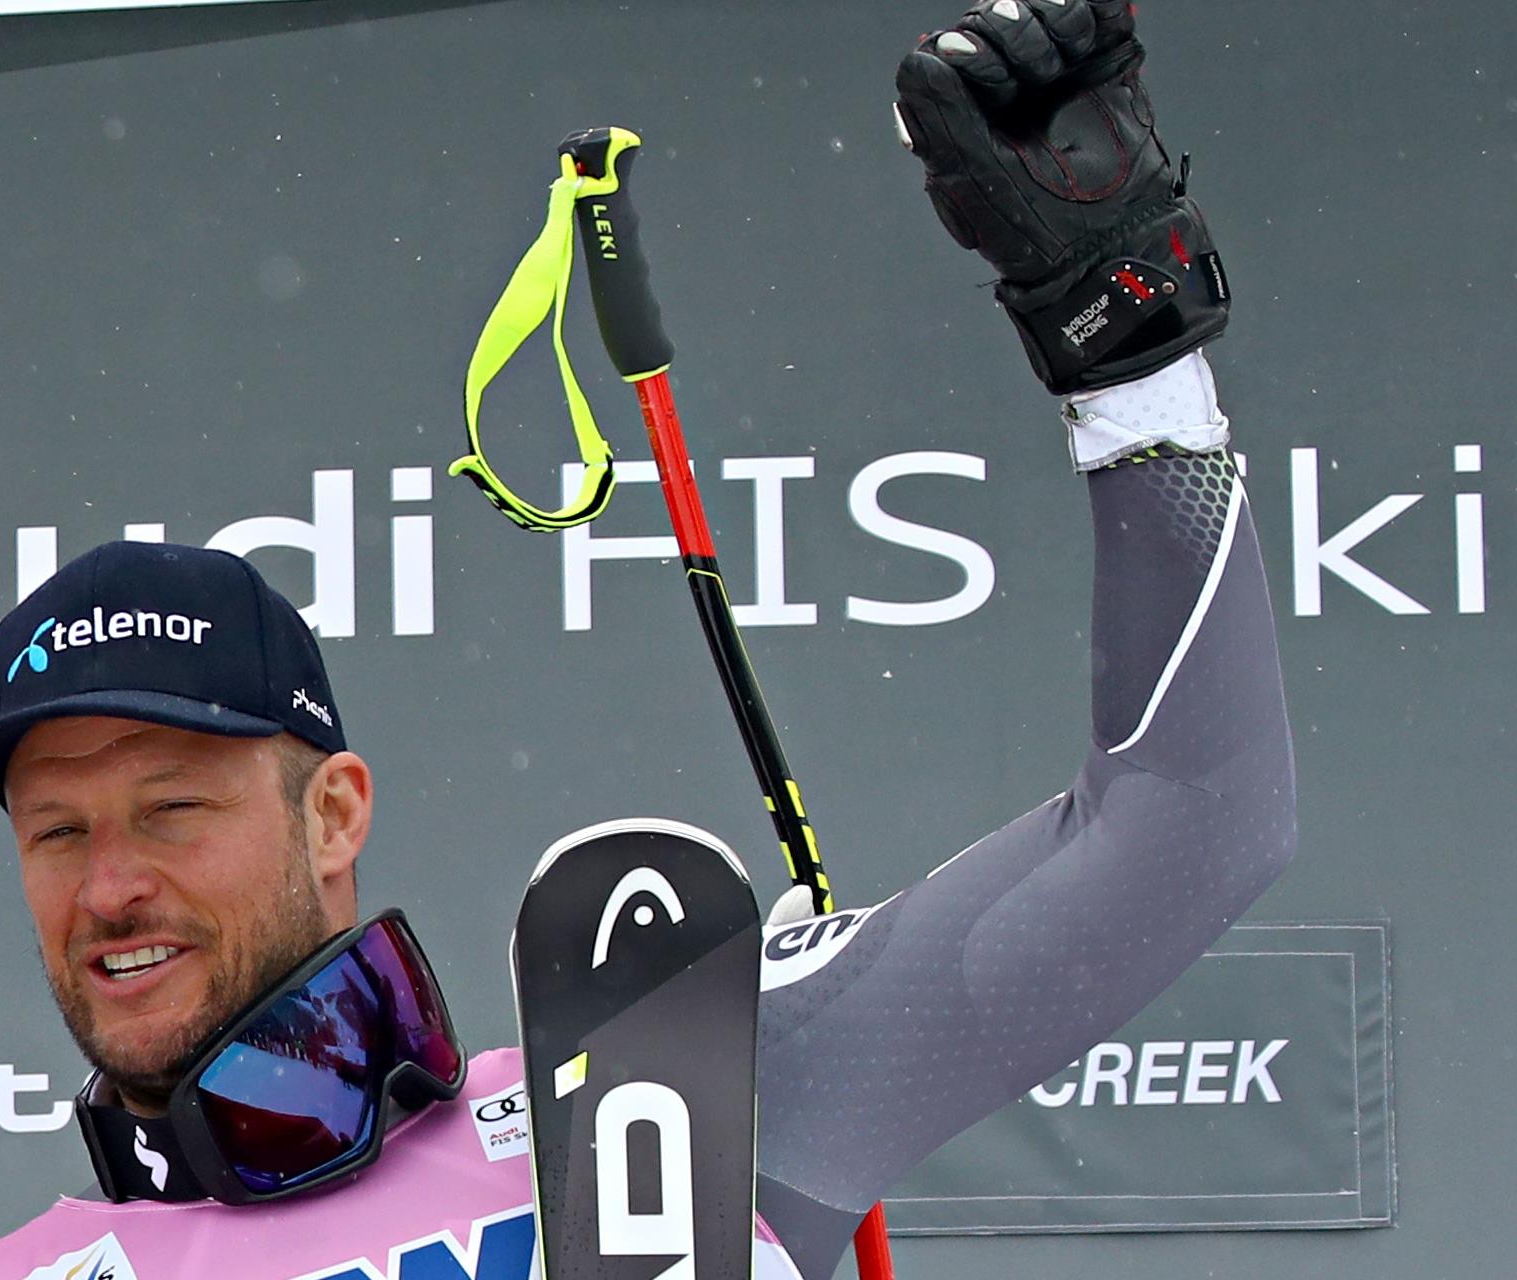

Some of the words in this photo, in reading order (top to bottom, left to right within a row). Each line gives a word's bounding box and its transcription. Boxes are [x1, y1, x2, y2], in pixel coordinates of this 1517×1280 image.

[591, 204, 618, 260] LEKI
[1071, 317, 1109, 346] RACING
[561, 449, 997, 631] FIS
[1235, 444, 1487, 618] ki
[51, 605, 213, 654] telenor
